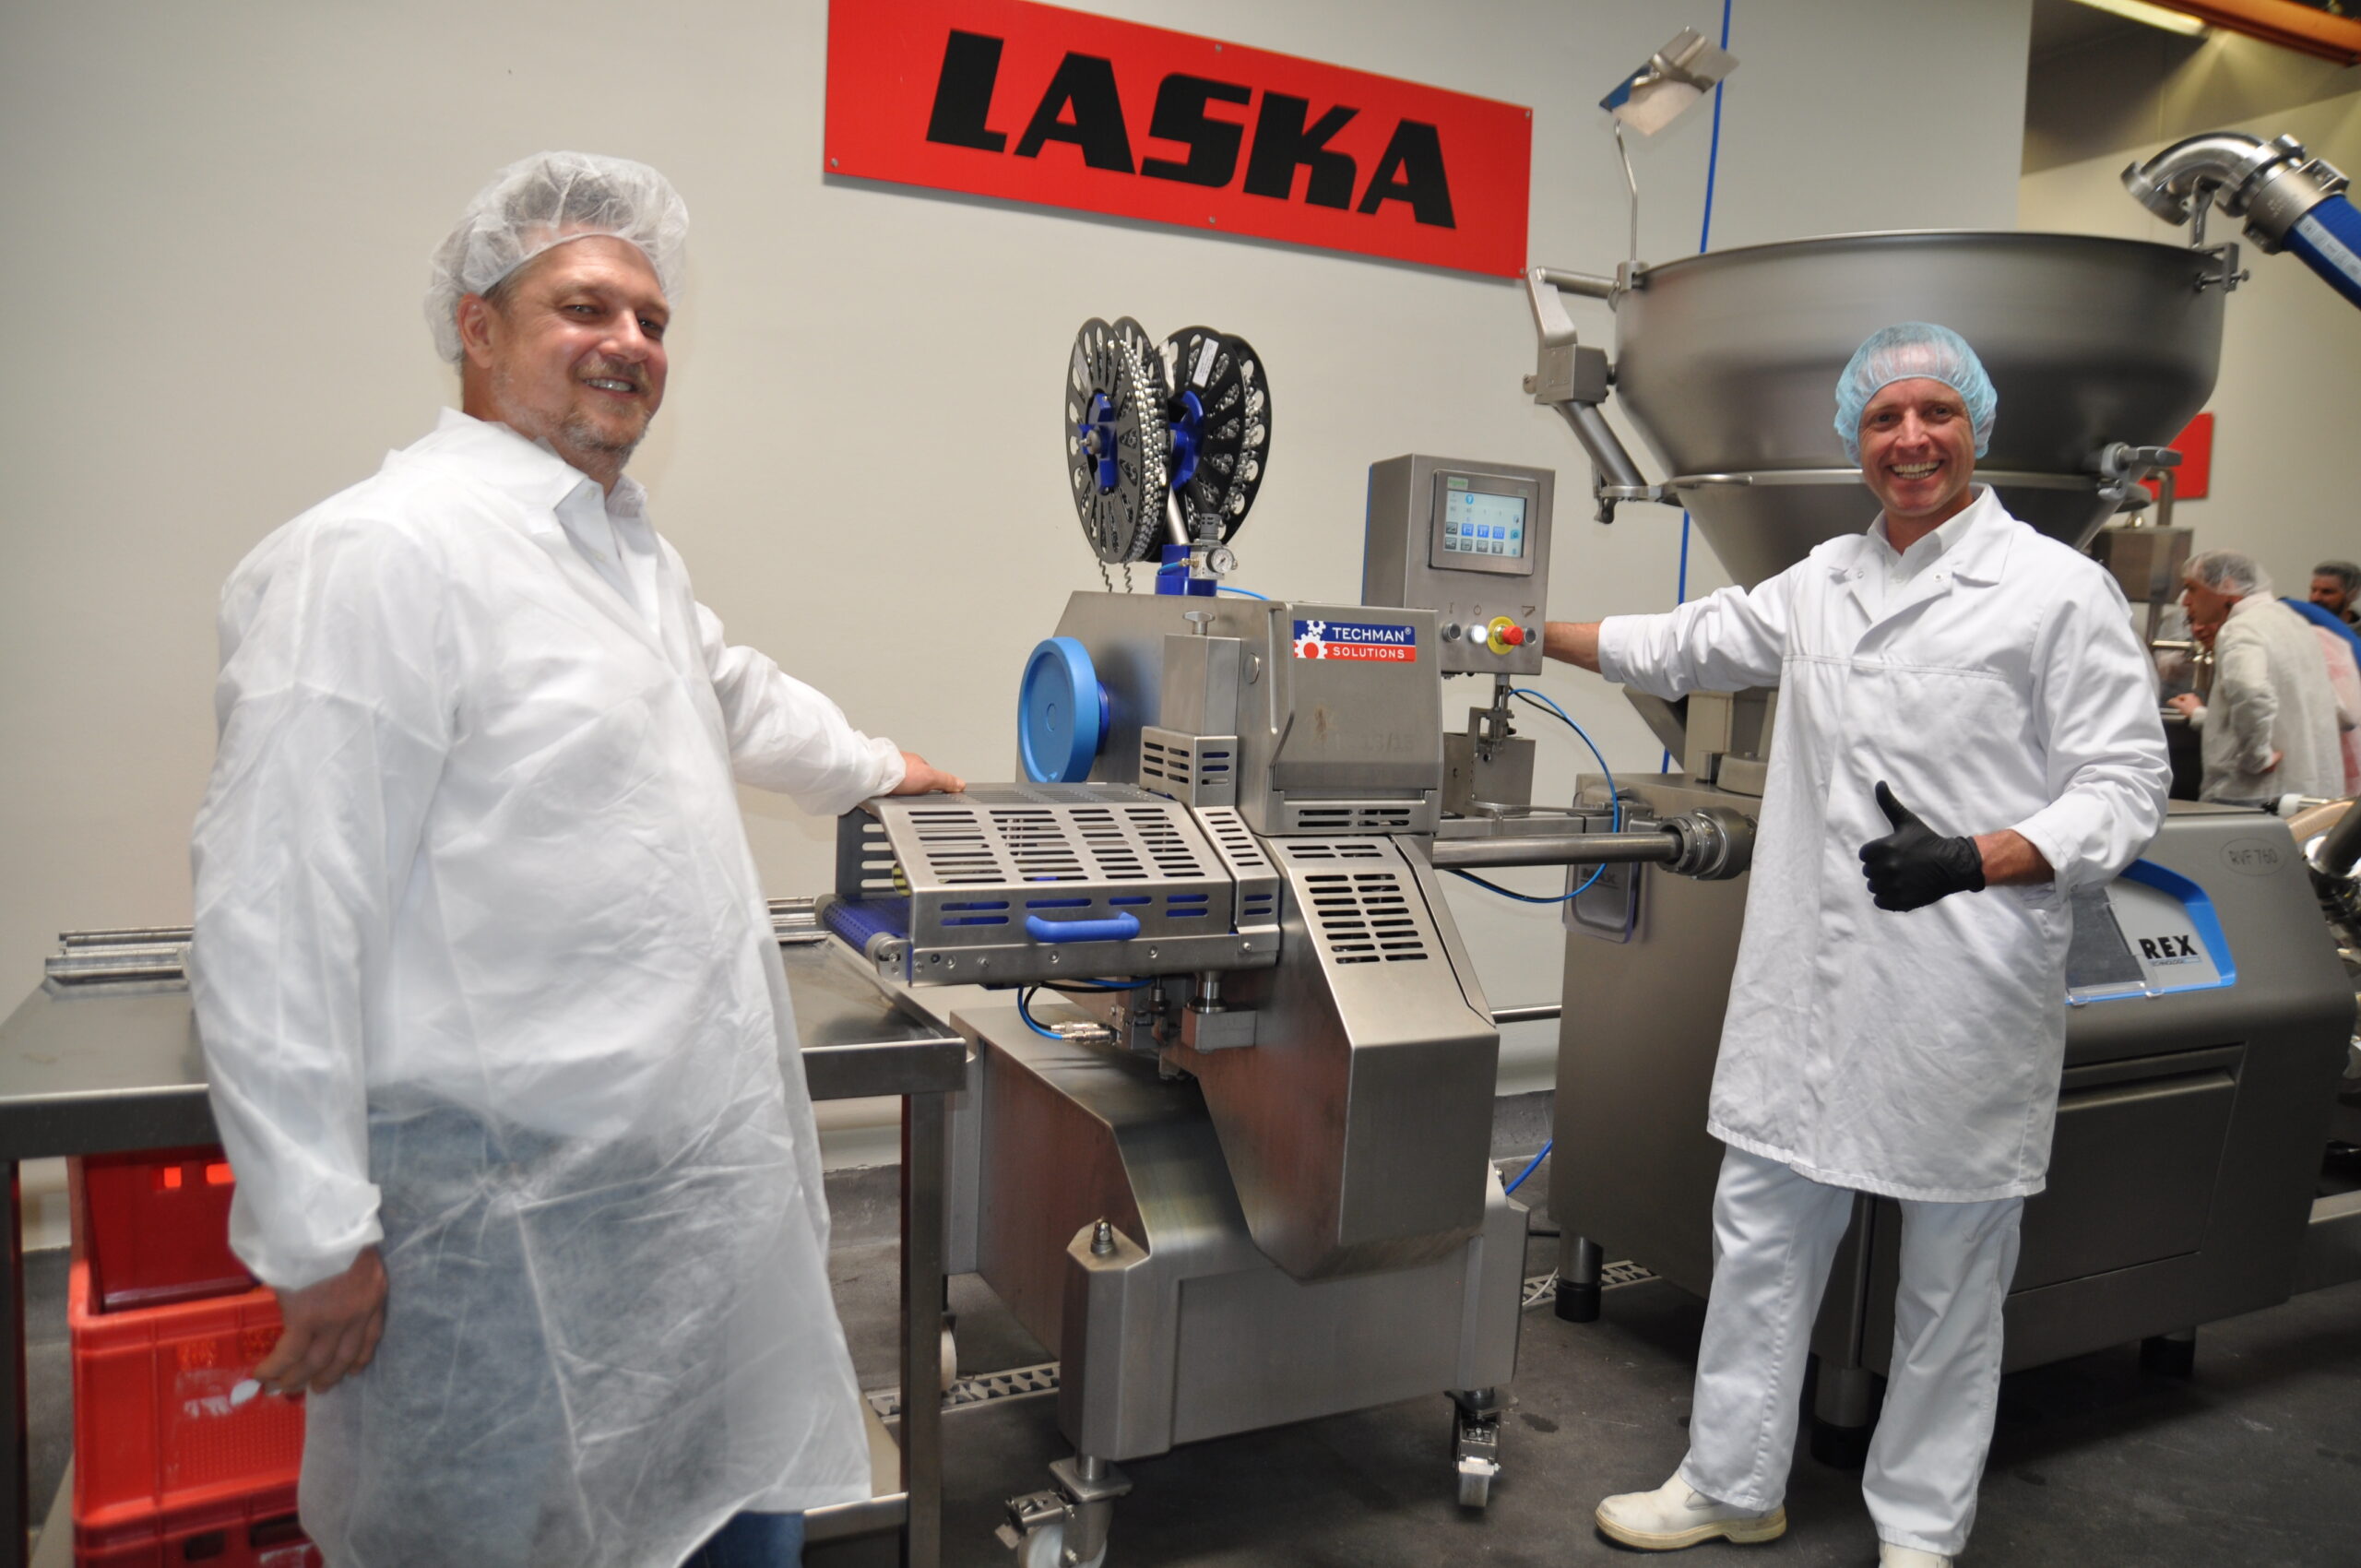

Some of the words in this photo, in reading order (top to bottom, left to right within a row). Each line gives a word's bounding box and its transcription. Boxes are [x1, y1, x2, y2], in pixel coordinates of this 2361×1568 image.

[926, 29, 1457, 230] LASKA
[1333, 647, 1405, 659] SOLUTIONS
[2139, 935, 2198, 959] REX
